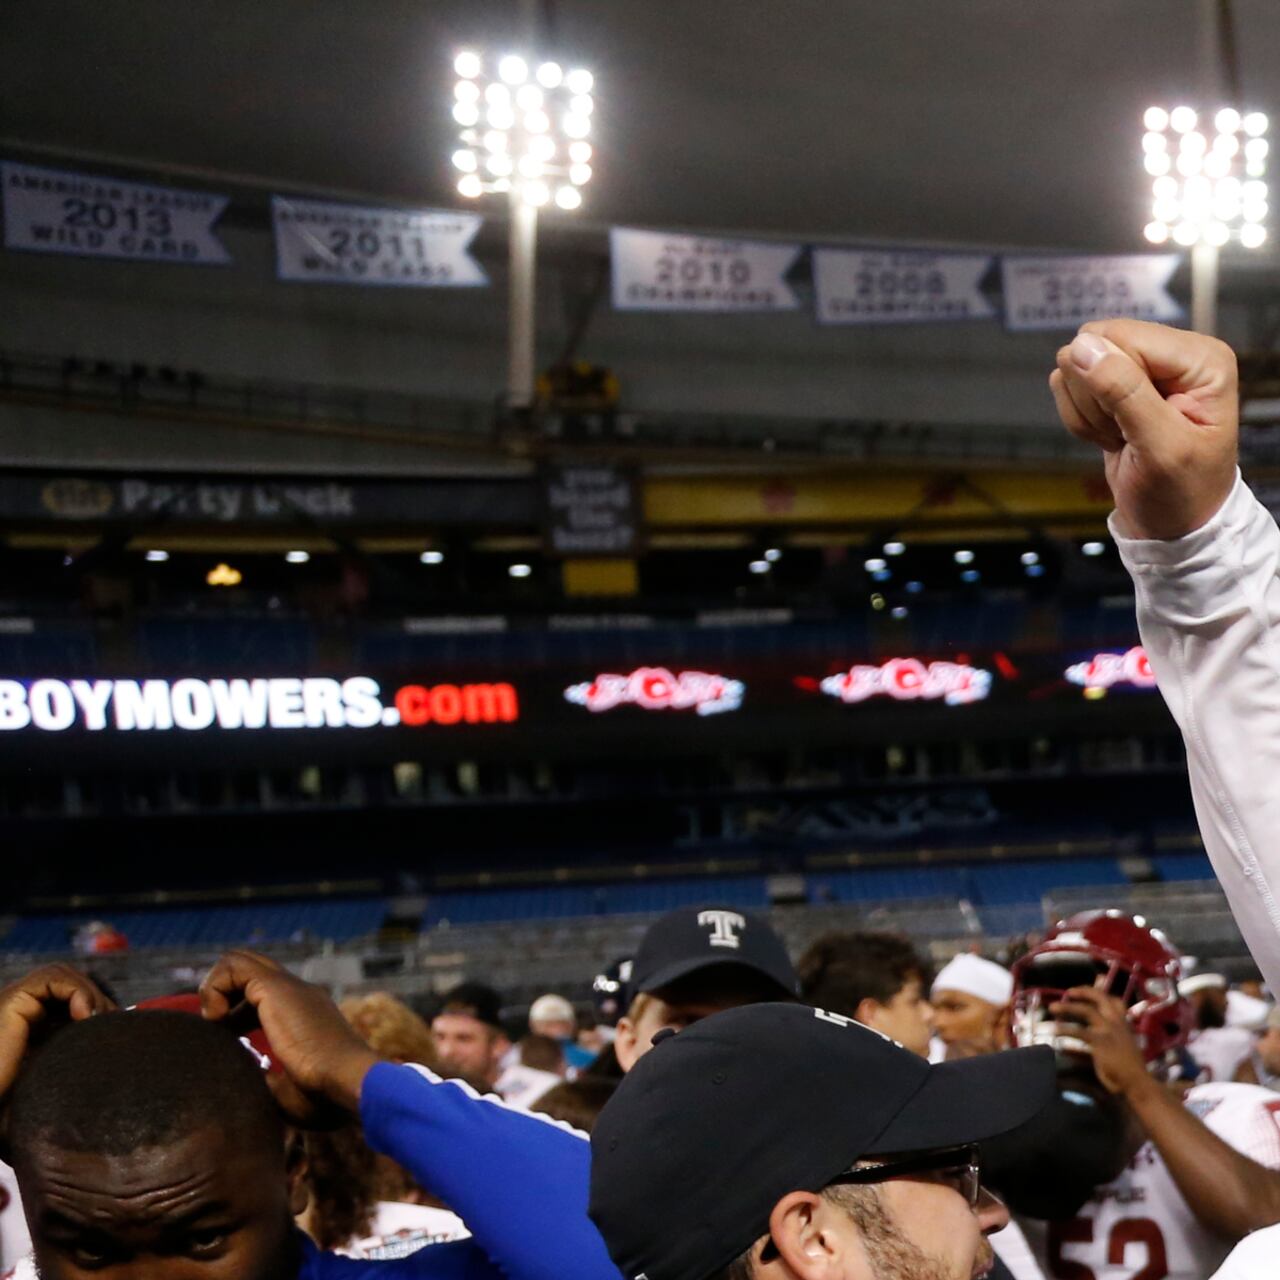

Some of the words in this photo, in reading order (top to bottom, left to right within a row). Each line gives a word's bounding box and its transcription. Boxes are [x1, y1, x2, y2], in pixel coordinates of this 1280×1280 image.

[62, 197, 173, 237] 2013
[30, 223, 104, 249] WILD
[118, 233, 200, 260] CARD
[328, 228, 425, 260] 2011
[655, 256, 752, 286] 2010
[697, 909, 747, 949] T
